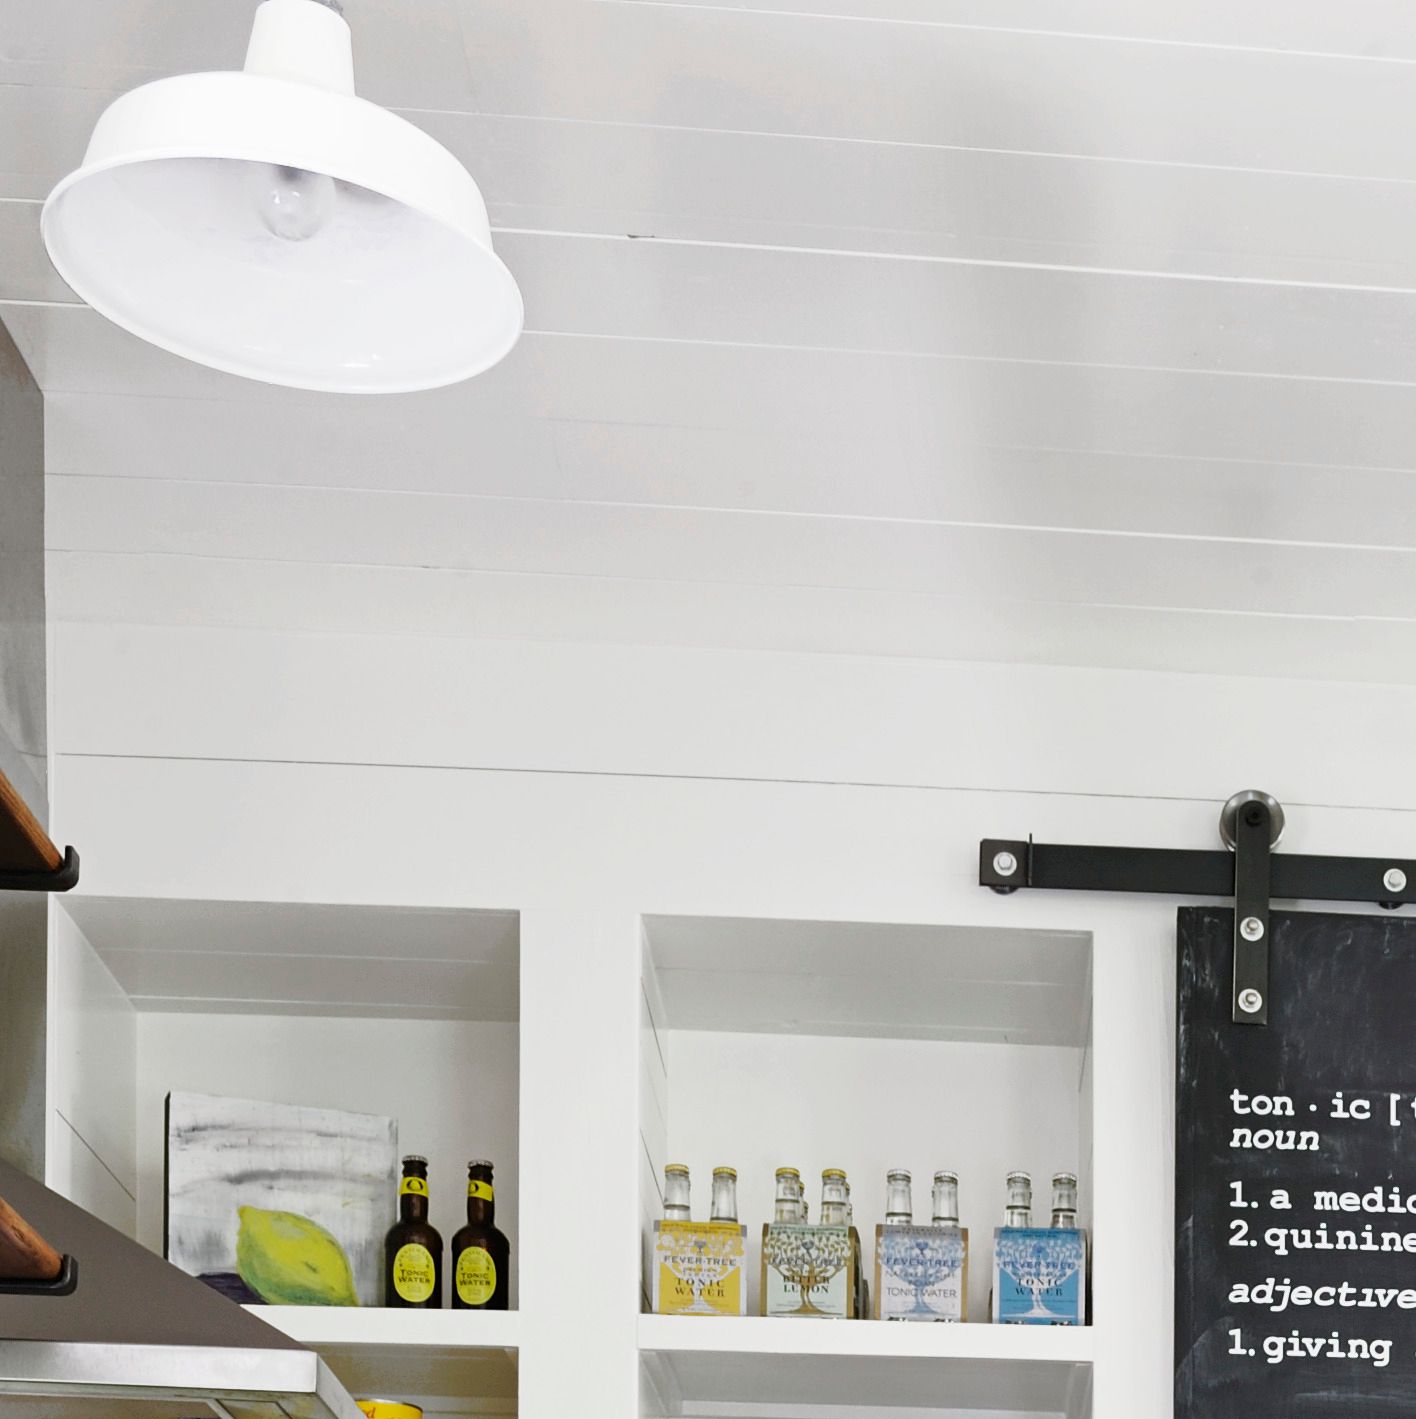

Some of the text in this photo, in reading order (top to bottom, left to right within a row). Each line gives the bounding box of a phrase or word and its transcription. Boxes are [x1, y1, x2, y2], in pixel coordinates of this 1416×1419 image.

[1230, 1088, 1295, 1116] ton
[1330, 1091, 1371, 1120] ic
[1230, 1128, 1320, 1150] noun
[1228, 1181, 1259, 1209] 1.
[1269, 1188, 1292, 1210] a
[676, 1278, 724, 1288] TONIC
